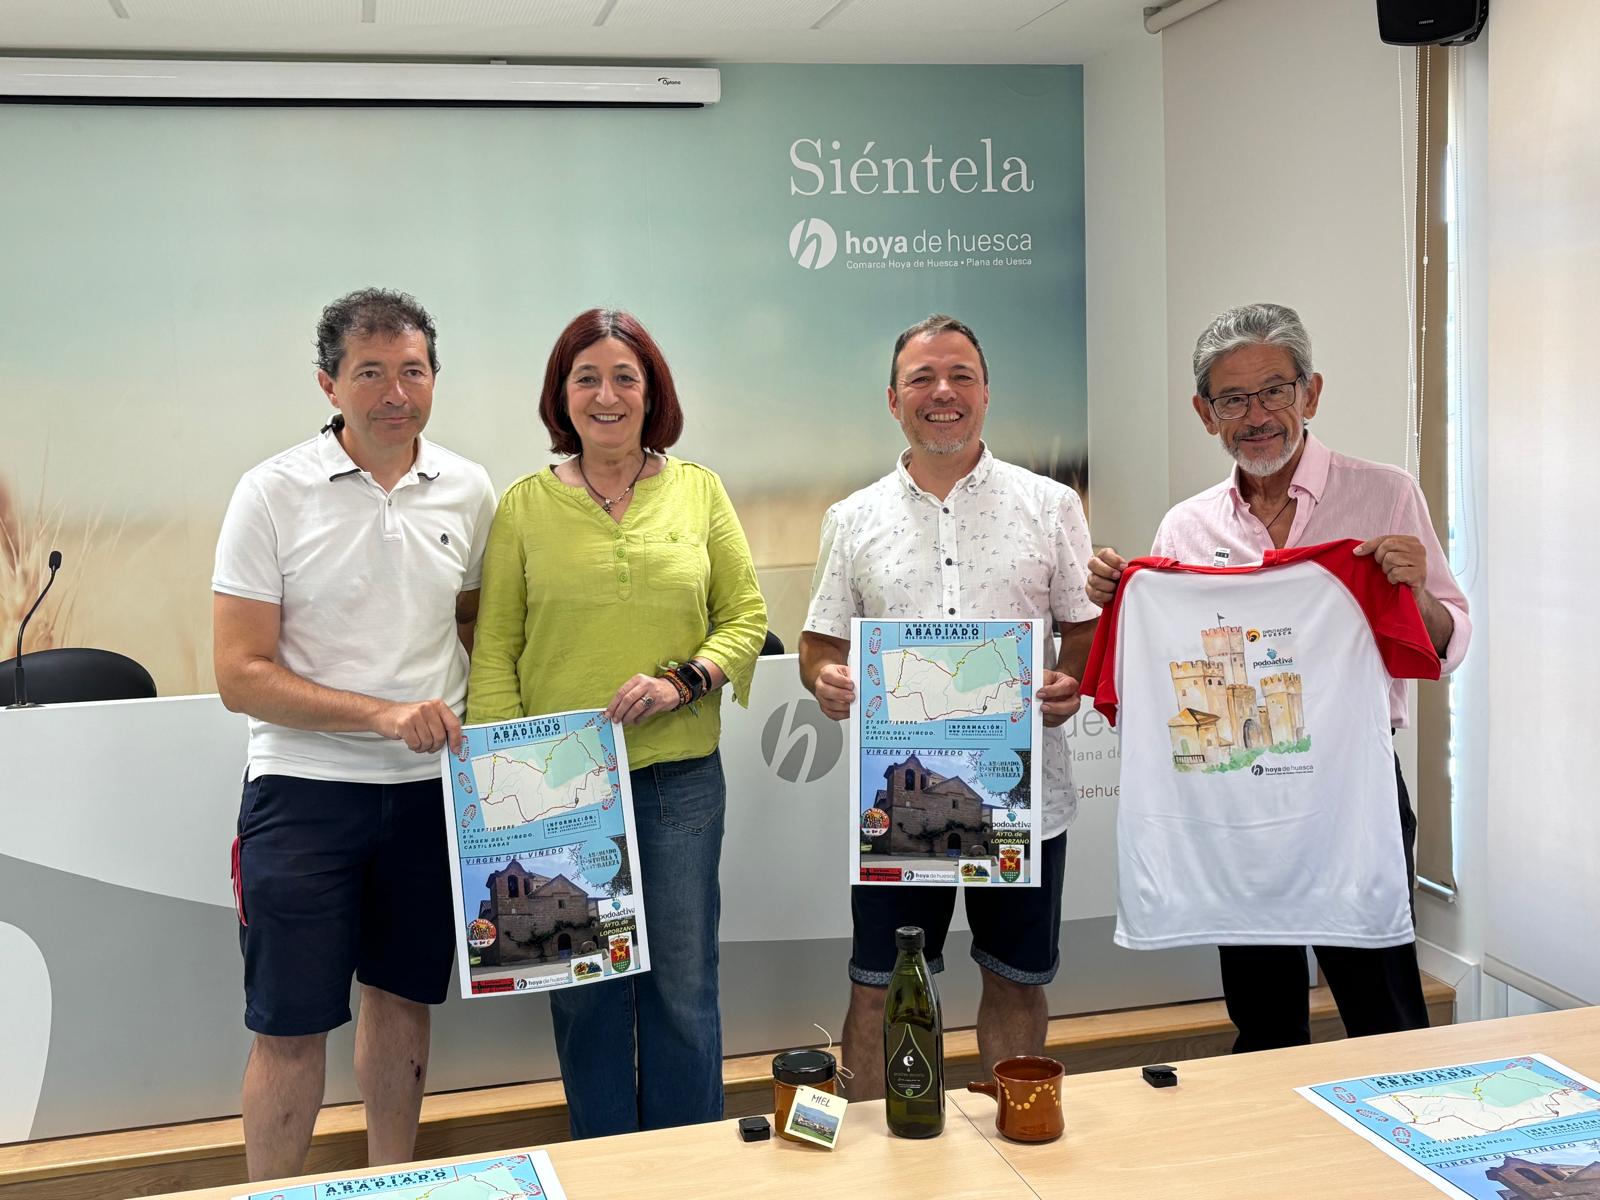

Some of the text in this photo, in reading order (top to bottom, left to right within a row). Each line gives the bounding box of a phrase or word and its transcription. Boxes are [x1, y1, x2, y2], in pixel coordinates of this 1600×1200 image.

[789, 138, 1034, 195] Siéntela
[846, 229, 1032, 258] hoya de huesca
[846, 257, 1032, 270] Comarca Hoya de Huesca Plana de Uesca
[905, 628, 979, 636] ABADIADO
[1252, 657, 1293, 669] podoactiva
[494, 723, 560, 740] ABADIADO
[473, 825, 515, 833] SEPTIEMBRE
[466, 856, 502, 865] VIRGEN
[600, 925, 636, 937] LOPORZANO
[1376, 1069, 1473, 1087] ABADIADO
[811, 1094, 830, 1108] MIEL
[1436, 1157, 1488, 1169] VIRGEN
[326, 1171, 446, 1194] ABADIADO
